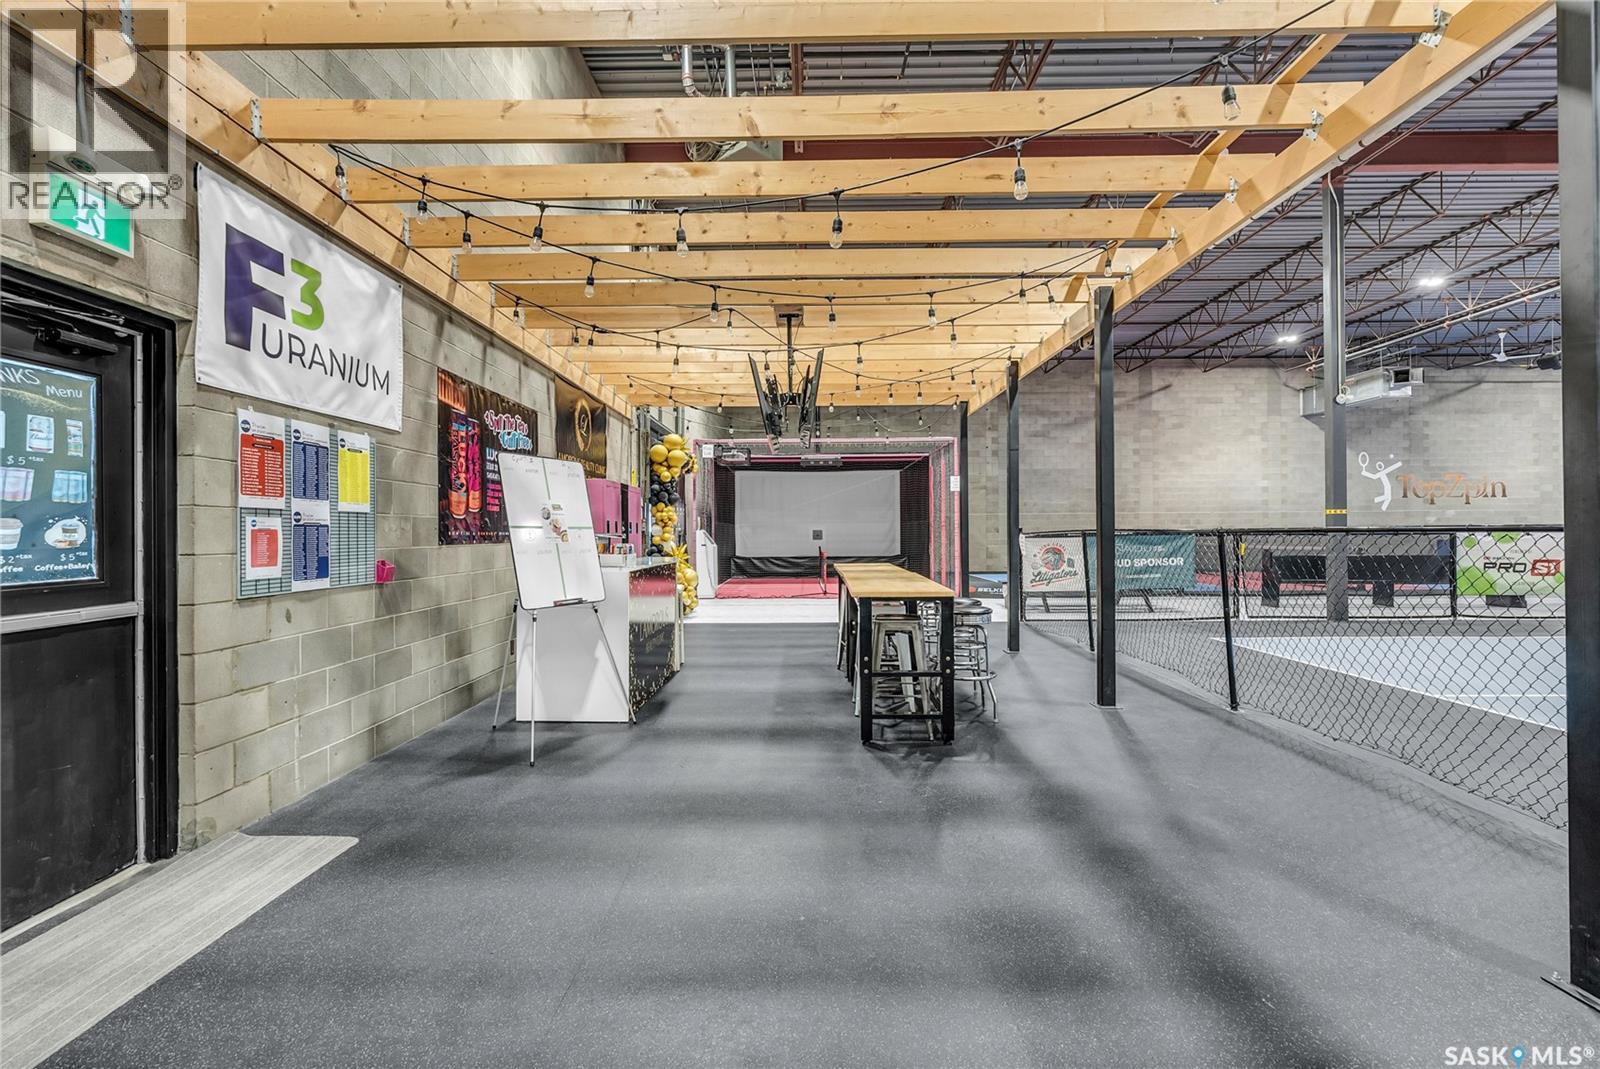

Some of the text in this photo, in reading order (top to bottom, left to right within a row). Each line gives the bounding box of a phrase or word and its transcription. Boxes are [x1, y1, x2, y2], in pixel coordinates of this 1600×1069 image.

[262, 322, 390, 396] URANIUM
[45, 385, 83, 399] Menu
[1133, 557, 1184, 567] SPONSOR
[1483, 561, 1527, 574] PRO
